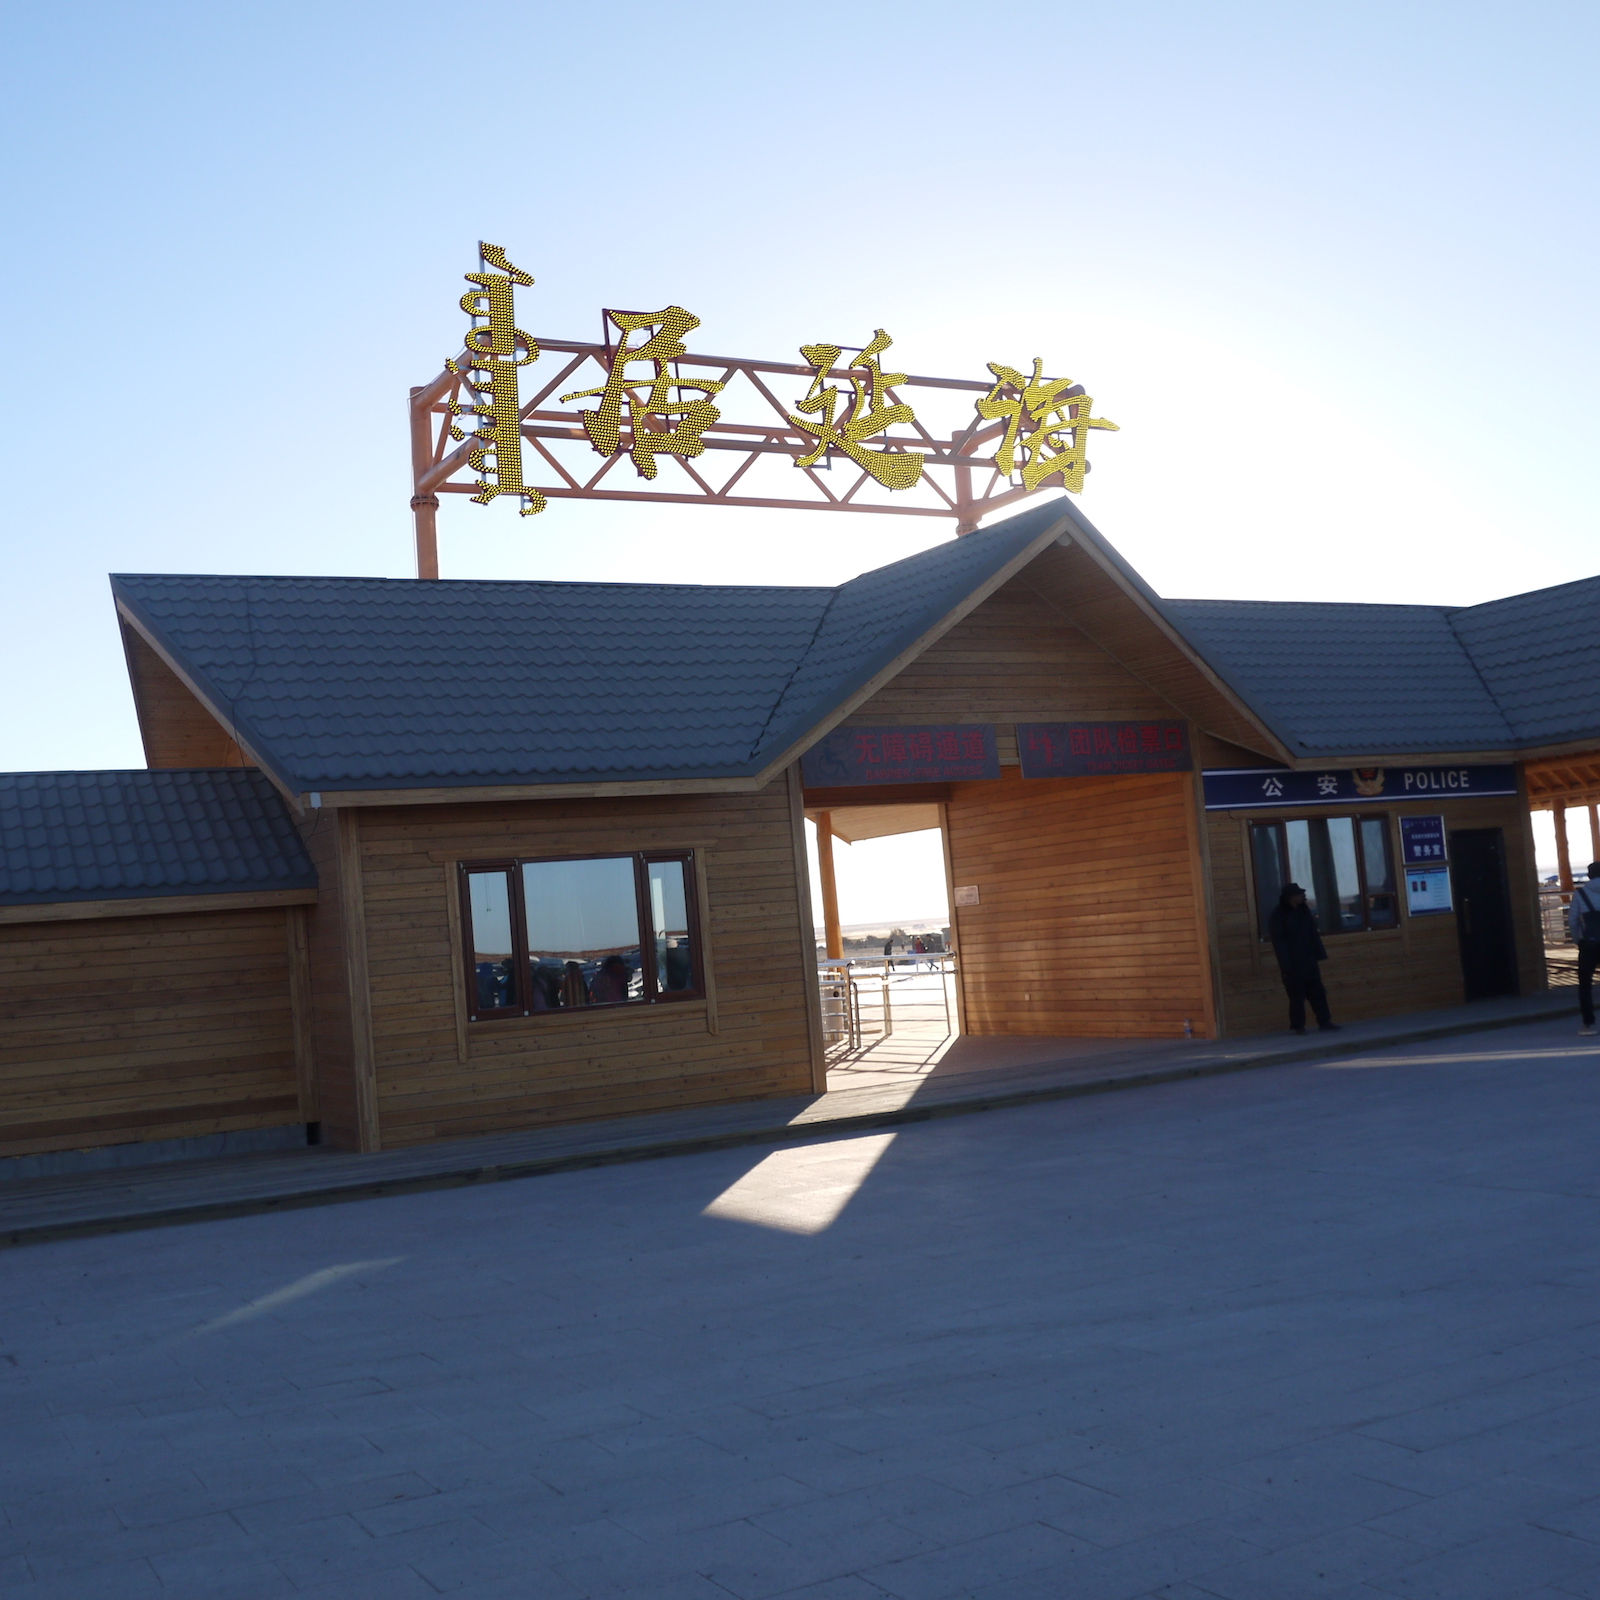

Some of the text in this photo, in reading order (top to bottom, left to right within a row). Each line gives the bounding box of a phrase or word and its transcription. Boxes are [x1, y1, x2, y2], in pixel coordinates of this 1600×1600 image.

[559, 304, 1120, 494] 居延海
[854, 730, 987, 764] 无障碍通道
[1069, 726, 1184, 756] 团队检票口
[865, 765, 984, 780] BARRIER-FREE ACCESS
[1086, 760, 1112, 771] TEAM
[1114, 759, 1143, 770] TICKET
[1261, 774, 1338, 798] 公安
[1404, 770, 1470, 791] POLICE
[1413, 844, 1441, 857] 警务室
